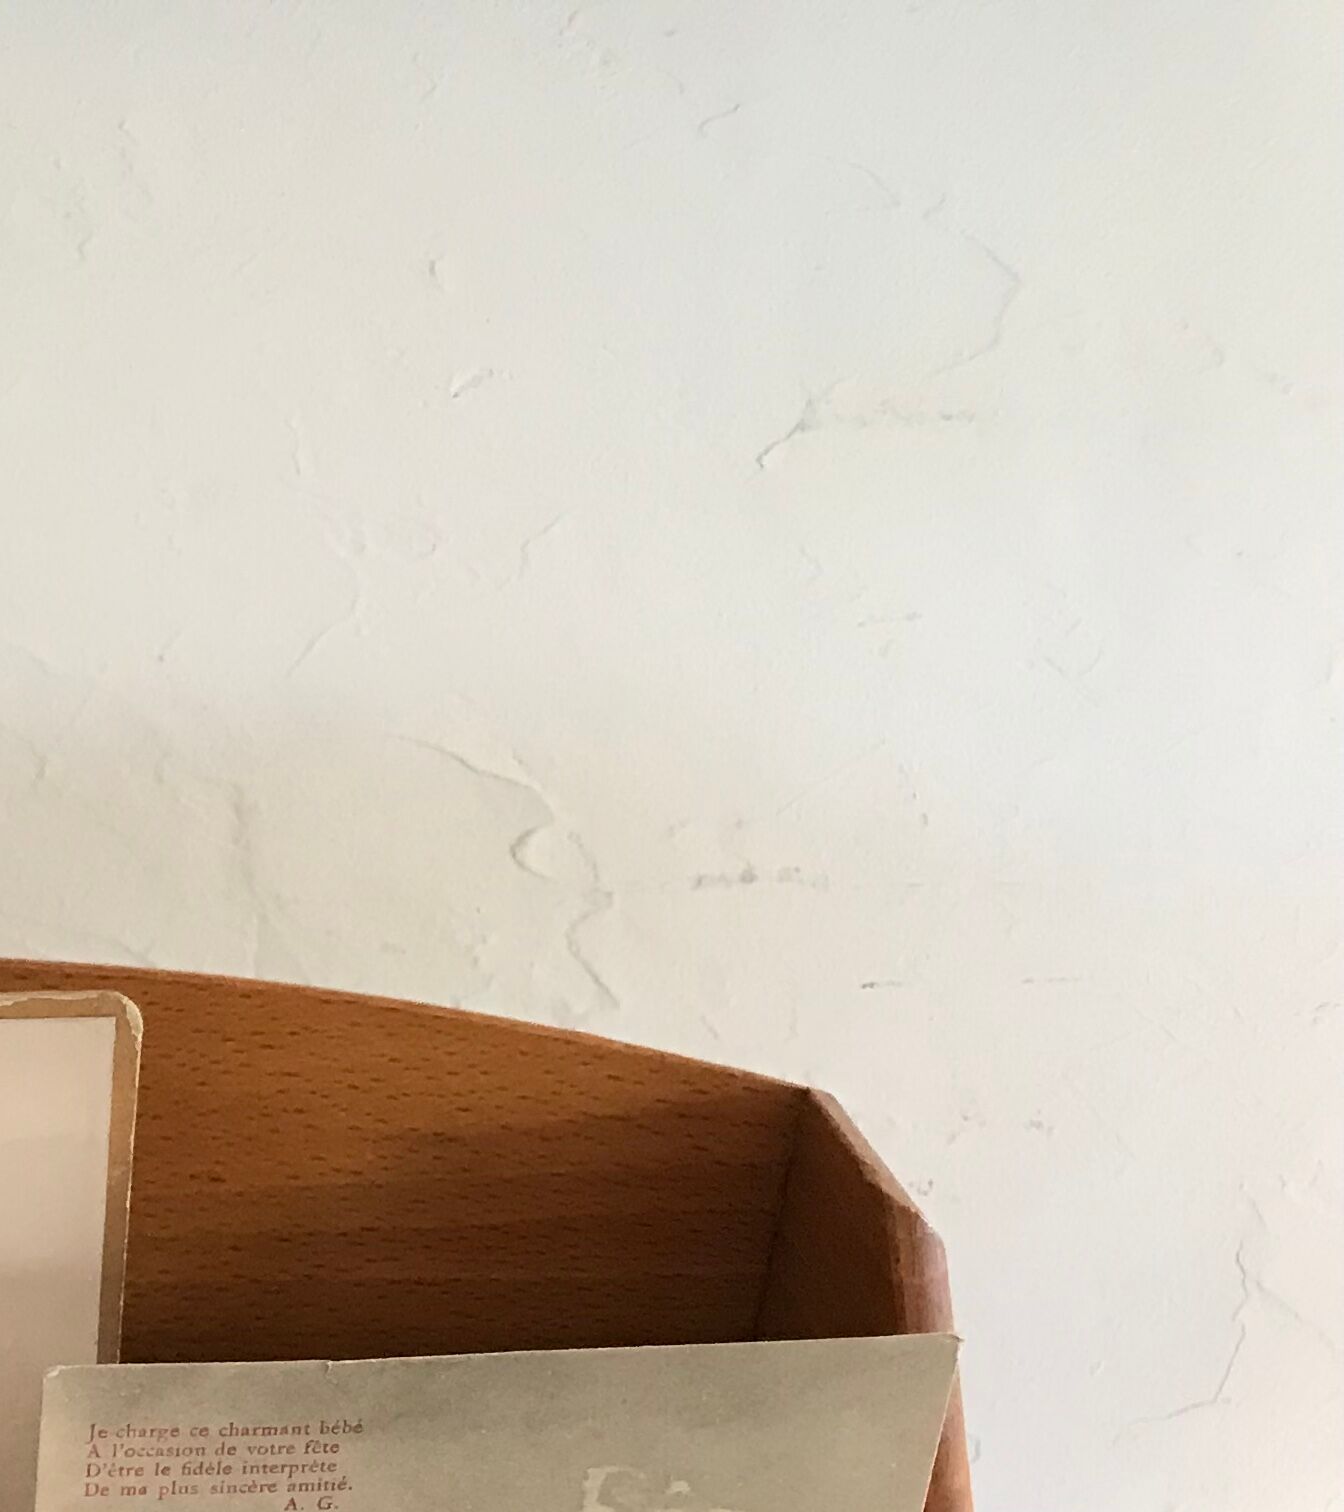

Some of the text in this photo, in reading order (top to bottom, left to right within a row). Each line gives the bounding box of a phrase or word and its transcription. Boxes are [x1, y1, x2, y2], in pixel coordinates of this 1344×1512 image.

[86, 1419, 364, 1444] Je charge ce charmant bébé
[215, 1441, 237, 1457] de
[248, 1443, 296, 1456] votre
[303, 1439, 340, 1455] fête
[154, 1462, 172, 1477] le
[181, 1460, 233, 1477] fidèle
[84, 1475, 353, 1501] De ma plus sincère amitié.
